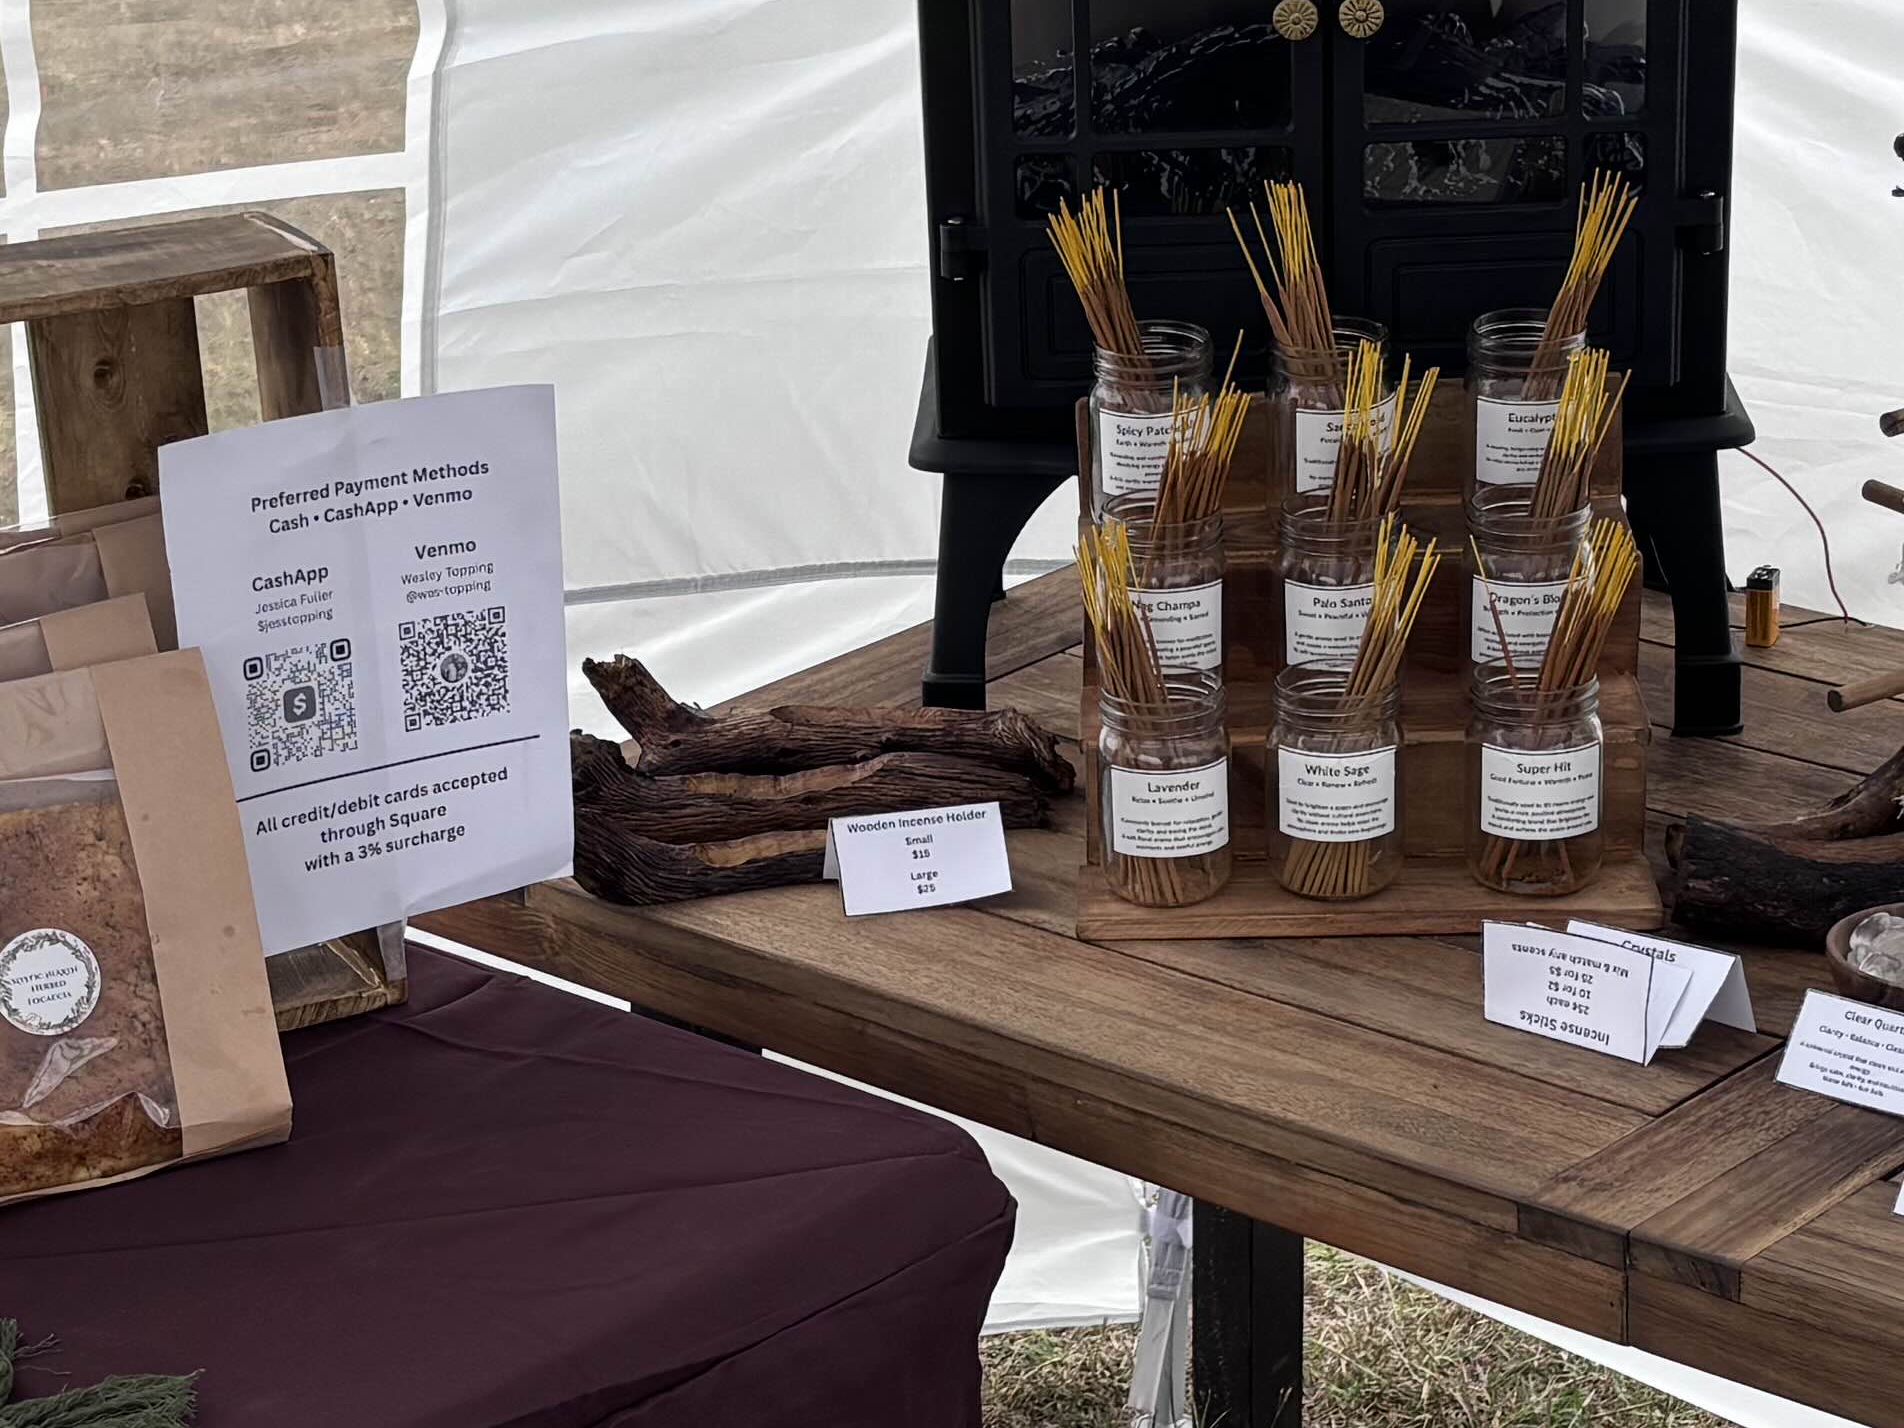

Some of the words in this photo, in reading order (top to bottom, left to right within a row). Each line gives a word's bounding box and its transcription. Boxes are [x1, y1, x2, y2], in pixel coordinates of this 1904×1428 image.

[1508, 412, 1556, 423] Eucalypt
[1116, 424, 1143, 438] Spicy
[251, 484, 330, 512] Preferred
[334, 471, 408, 501] Payment
[413, 460, 489, 483] Methods
[269, 513, 309, 533] Cash
[324, 498, 399, 524] CashApp
[413, 487, 473, 508] Venmo
[415, 538, 476, 560] Venmo
[252, 565, 329, 593] CashApp
[401, 568, 443, 587] Wesley
[445, 562, 494, 581] Topping
[255, 594, 296, 616] Jessica
[299, 589, 334, 607] Fuller
[1157, 601, 1200, 611] Champa
[1313, 597, 1336, 608] Palo
[1490, 592, 1539, 606] Dragon's
[257, 607, 334, 633] $jesstopping
[1305, 764, 1340, 776] White
[1344, 764, 1370, 776] Sage
[1517, 763, 1551, 775] Super
[1554, 761, 1571, 772] Hit
[1148, 780, 1200, 793] Lavender
[256, 816, 278, 836] All
[281, 792, 381, 830] credit/debit
[384, 783, 428, 806] cards
[432, 767, 508, 797] accepted
[320, 818, 386, 845] through
[389, 803, 447, 831] Square
[847, 819, 896, 834] Wooden
[898, 816, 943, 828] Incense
[946, 810, 986, 822] Holder
[905, 834, 933, 846] Small
[305, 851, 341, 873] with
[344, 850, 355, 863] a
[358, 841, 382, 860] 3%
[386, 824, 465, 854] surcharge
[912, 850, 930, 859] $15
[911, 870, 938, 881] Large
[917, 884, 936, 894] $25
[1512, 943, 1542, 957] scents
[1548, 946, 1566, 961] any
[1570, 954, 1602, 970] match
[1562, 970, 1578, 981] for
[1615, 963, 1629, 978] Mix
[1548, 981, 1560, 992] $2
[1563, 985, 1577, 996] for
[1579, 988, 1591, 999] 10
[1546, 995, 1568, 1009] each
[1520, 1010, 1557, 1032] Sticks
[1845, 1010, 1871, 1025] Clear
[1560, 1022, 1609, 1046] Incense
